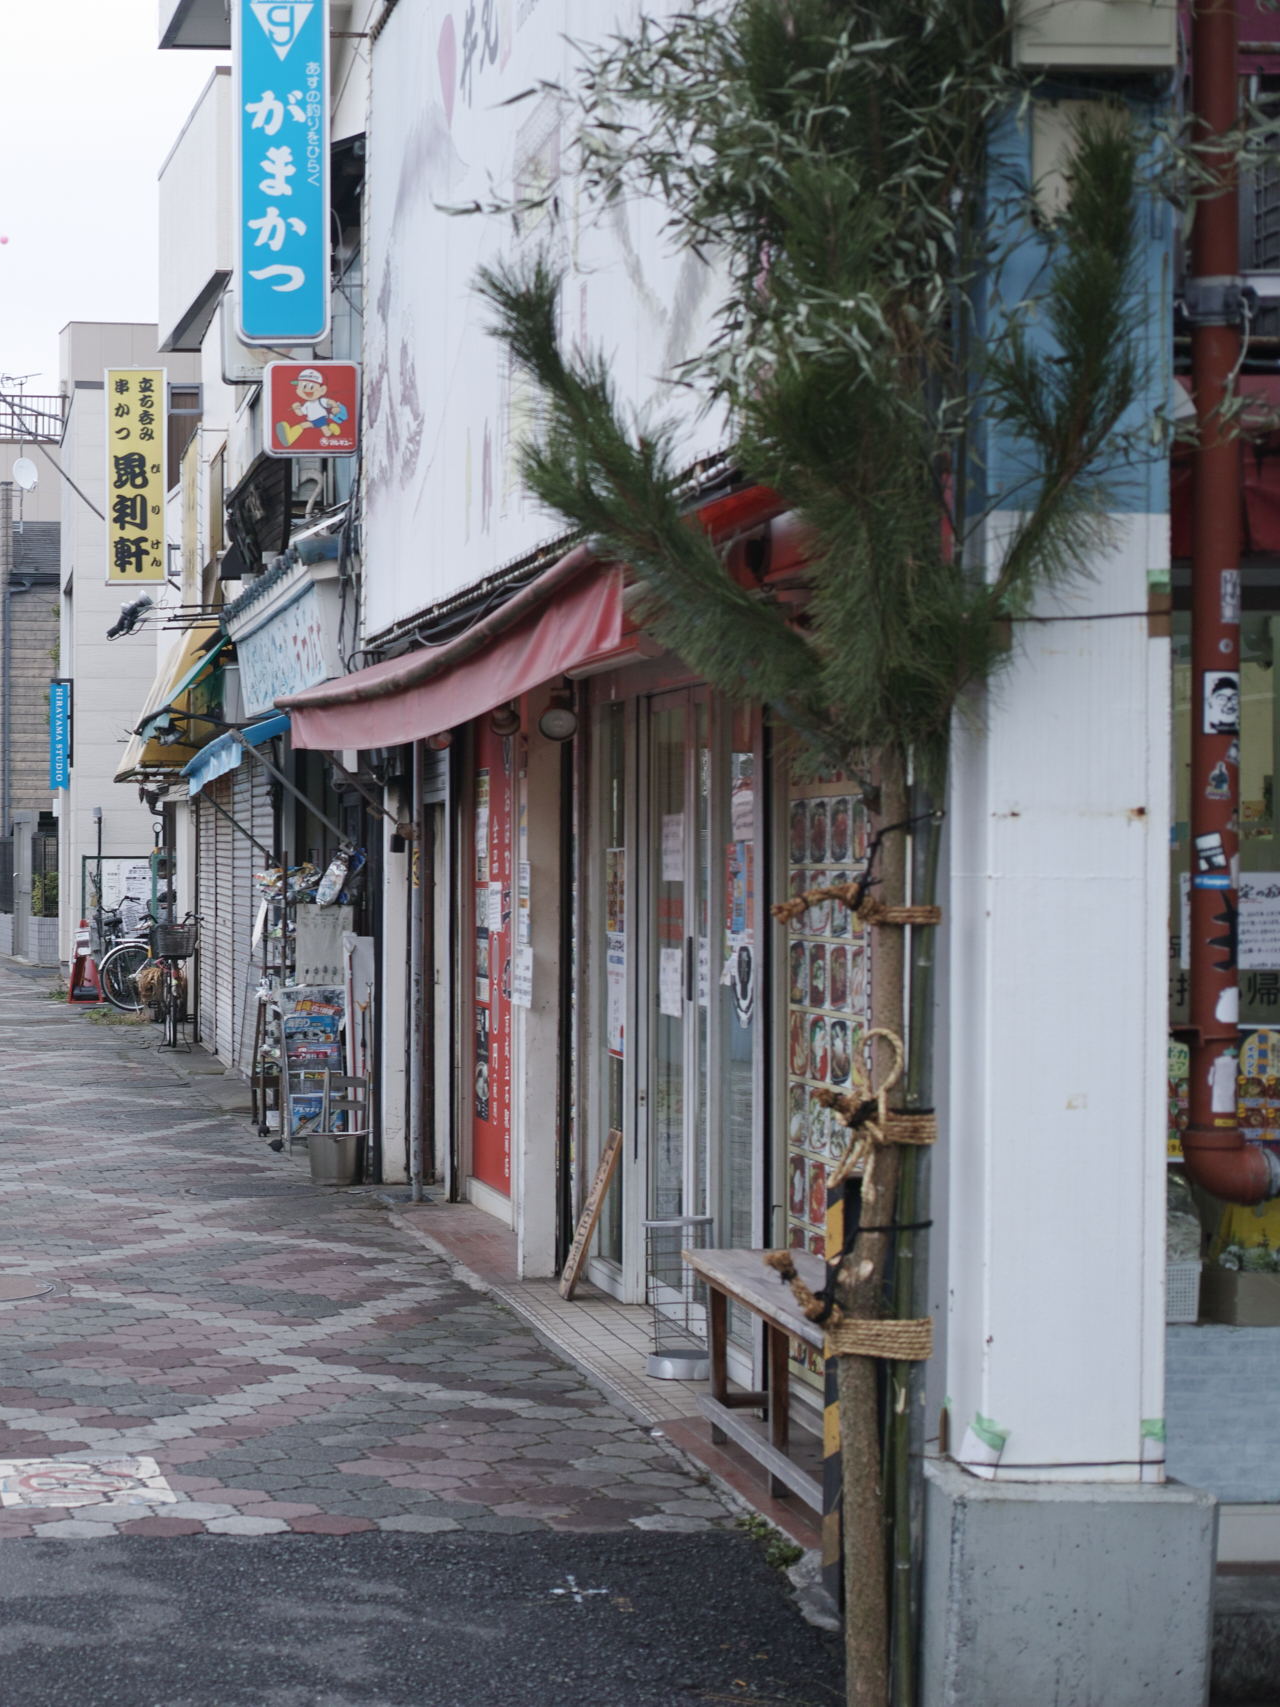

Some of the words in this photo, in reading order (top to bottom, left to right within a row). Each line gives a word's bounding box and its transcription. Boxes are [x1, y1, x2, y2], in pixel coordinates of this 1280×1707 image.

[306, 62, 320, 187] あすの釣りをひらく
[245, 89, 307, 292] がまかつ
[115, 378, 131, 440] 串かつ
[138, 377, 155, 441] 立ち呑み
[55, 688, 63, 741] HIRAYAMA
[55, 743, 63, 782] STUDIO
